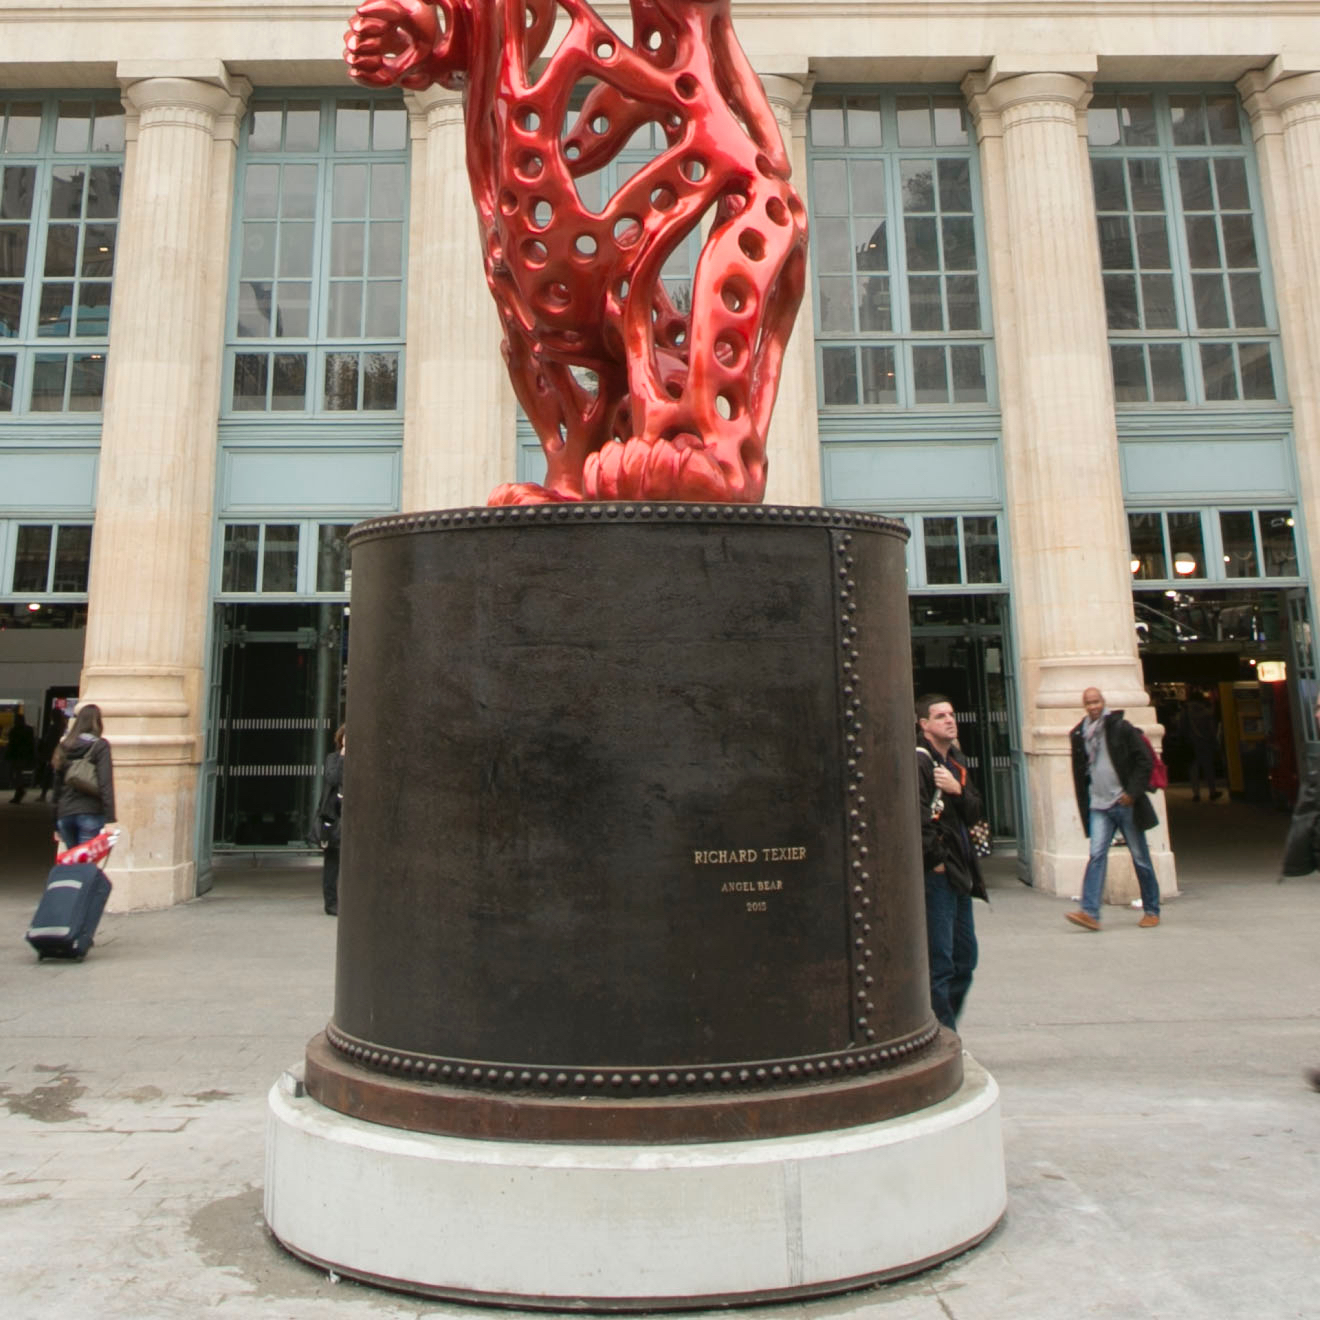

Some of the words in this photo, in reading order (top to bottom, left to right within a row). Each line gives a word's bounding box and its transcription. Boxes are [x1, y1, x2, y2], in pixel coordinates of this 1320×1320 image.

[694, 849, 758, 865] RICHARD
[762, 846, 807, 862] TEXIER
[721, 881, 756, 892] ANGEL
[757, 880, 783, 891] BEAR
[746, 901, 767, 912] 2015
